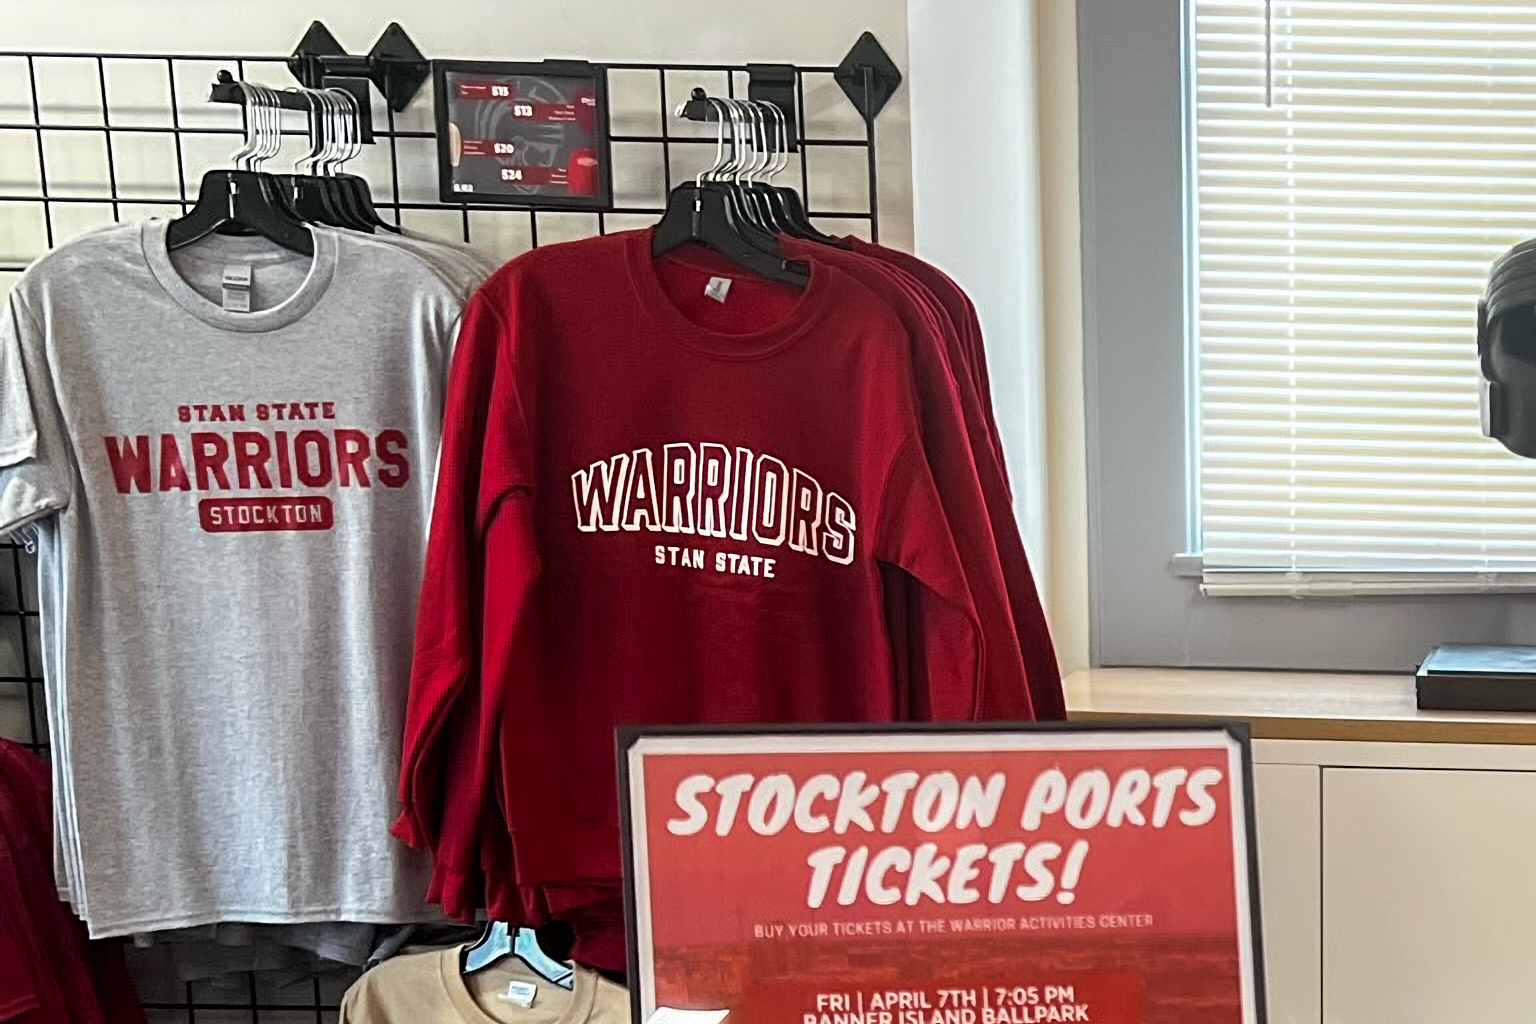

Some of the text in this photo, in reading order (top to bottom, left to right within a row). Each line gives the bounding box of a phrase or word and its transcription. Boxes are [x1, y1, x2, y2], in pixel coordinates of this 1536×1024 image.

[177, 401, 336, 423] STAN STATE
[104, 428, 411, 495] WARRIORS
[210, 503, 323, 525] STOCKTON
[571, 442, 857, 565] WARRIORS
[655, 545, 777, 579] STAN STATE
[667, 768, 1222, 836] STOCKTON PORTS
[806, 839, 1090, 909] TICKETS!
[754, 913, 1154, 938] BUY YOUR TICKETS AT THE WARRIOR ACTIVITIES CENTER
[816, 993, 851, 1012] FRI
[870, 989, 932, 1011] APRIL
[938, 988, 976, 1008] 7TH
[995, 986, 1039, 1006] 7:05
[1044, 984, 1075, 1004] PM
[982, 1004, 1090, 1024] BALLPARK
